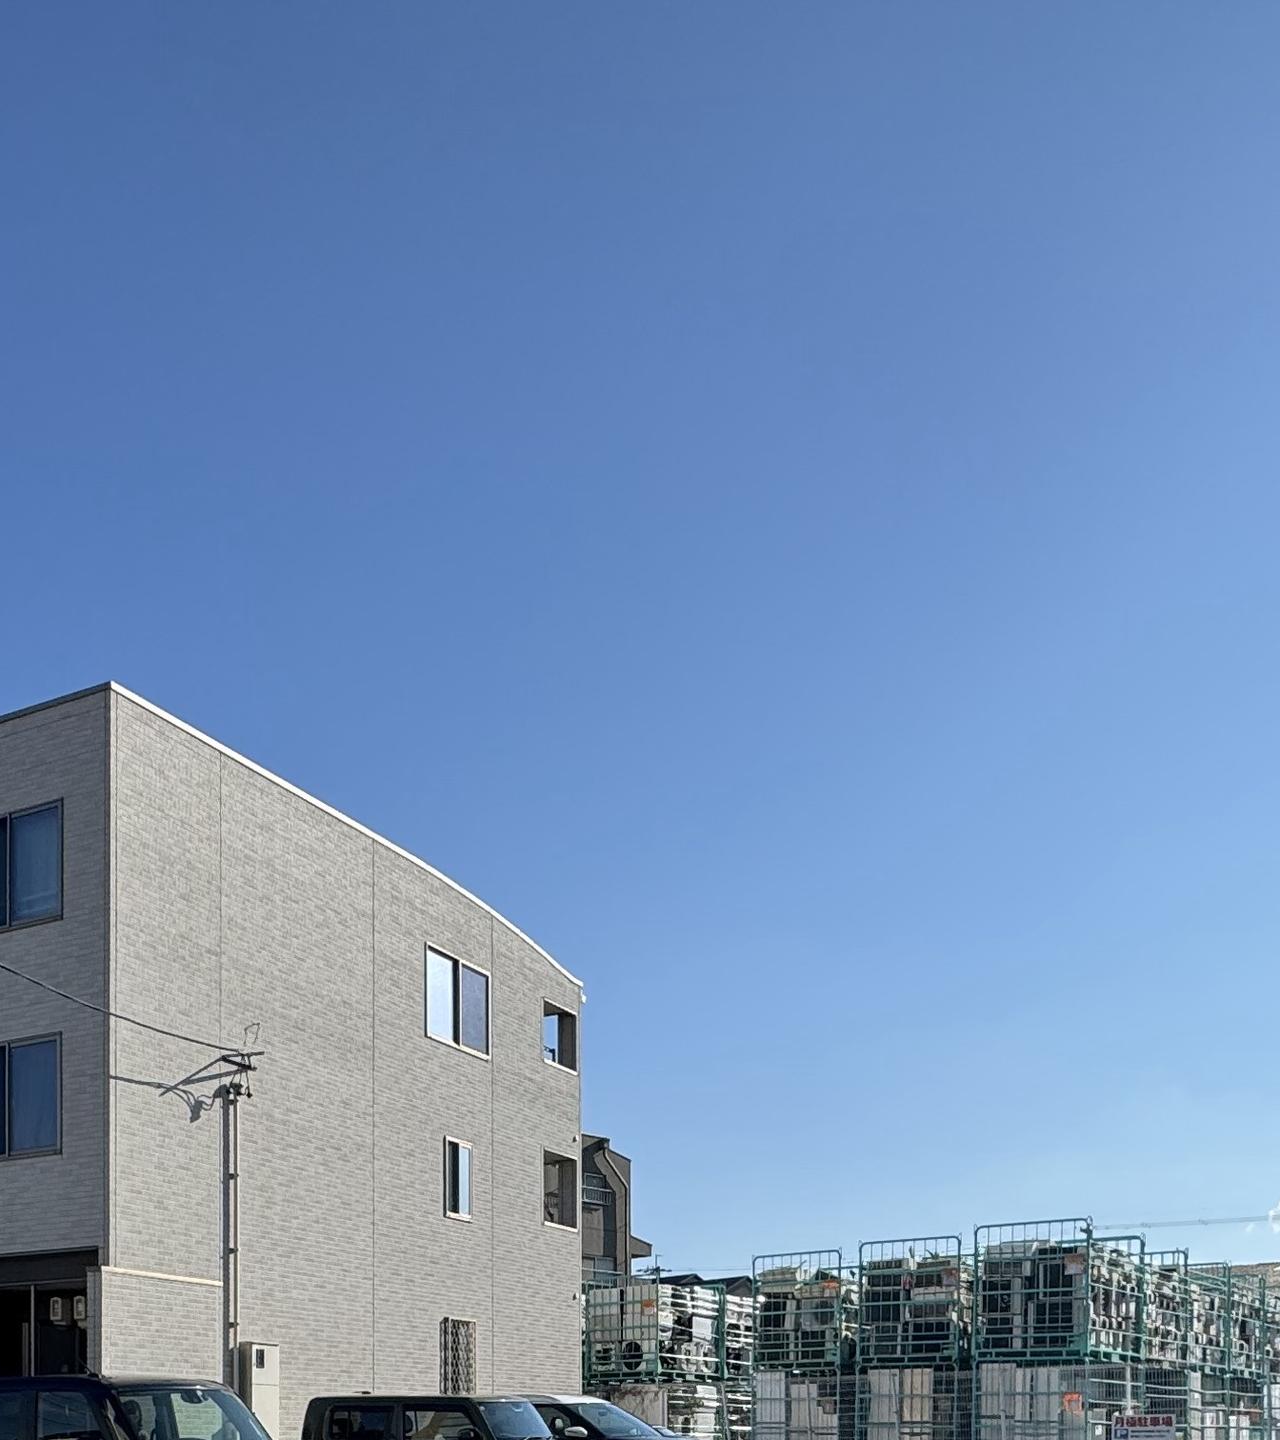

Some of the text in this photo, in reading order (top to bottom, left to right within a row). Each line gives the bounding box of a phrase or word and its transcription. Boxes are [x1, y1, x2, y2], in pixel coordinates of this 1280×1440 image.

[1114, 1415, 1173, 1428] 月極駐車場
